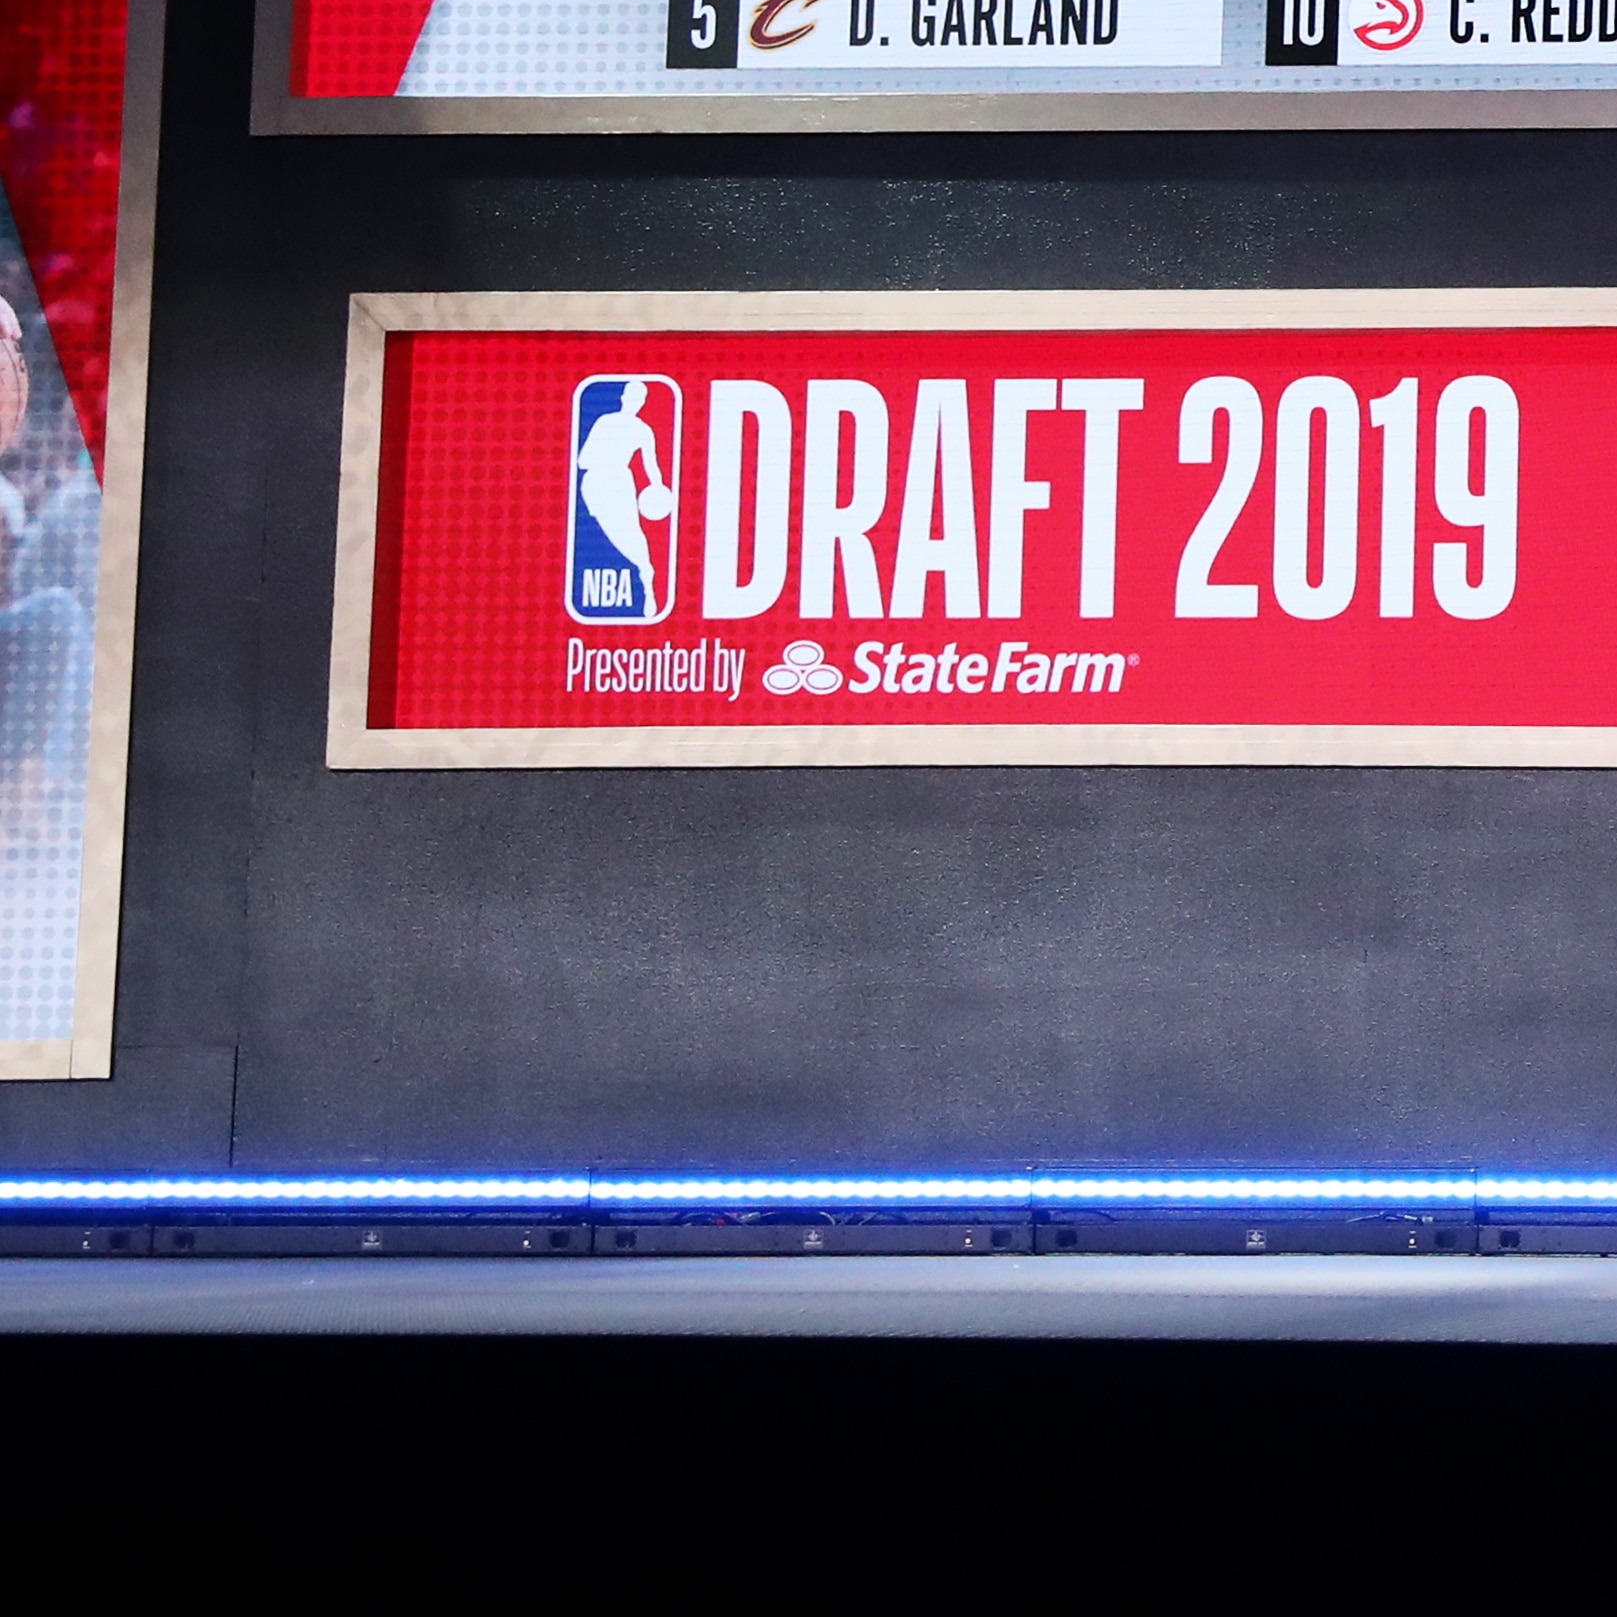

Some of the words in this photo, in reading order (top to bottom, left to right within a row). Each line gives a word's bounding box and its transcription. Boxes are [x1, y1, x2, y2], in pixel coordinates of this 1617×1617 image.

[702, 378, 1144, 620] DRAFT
[1174, 375, 1519, 621] 2019
[581, 568, 632, 608] NBA
[566, 637, 707, 693] Presented
[713, 637, 745, 702] by
